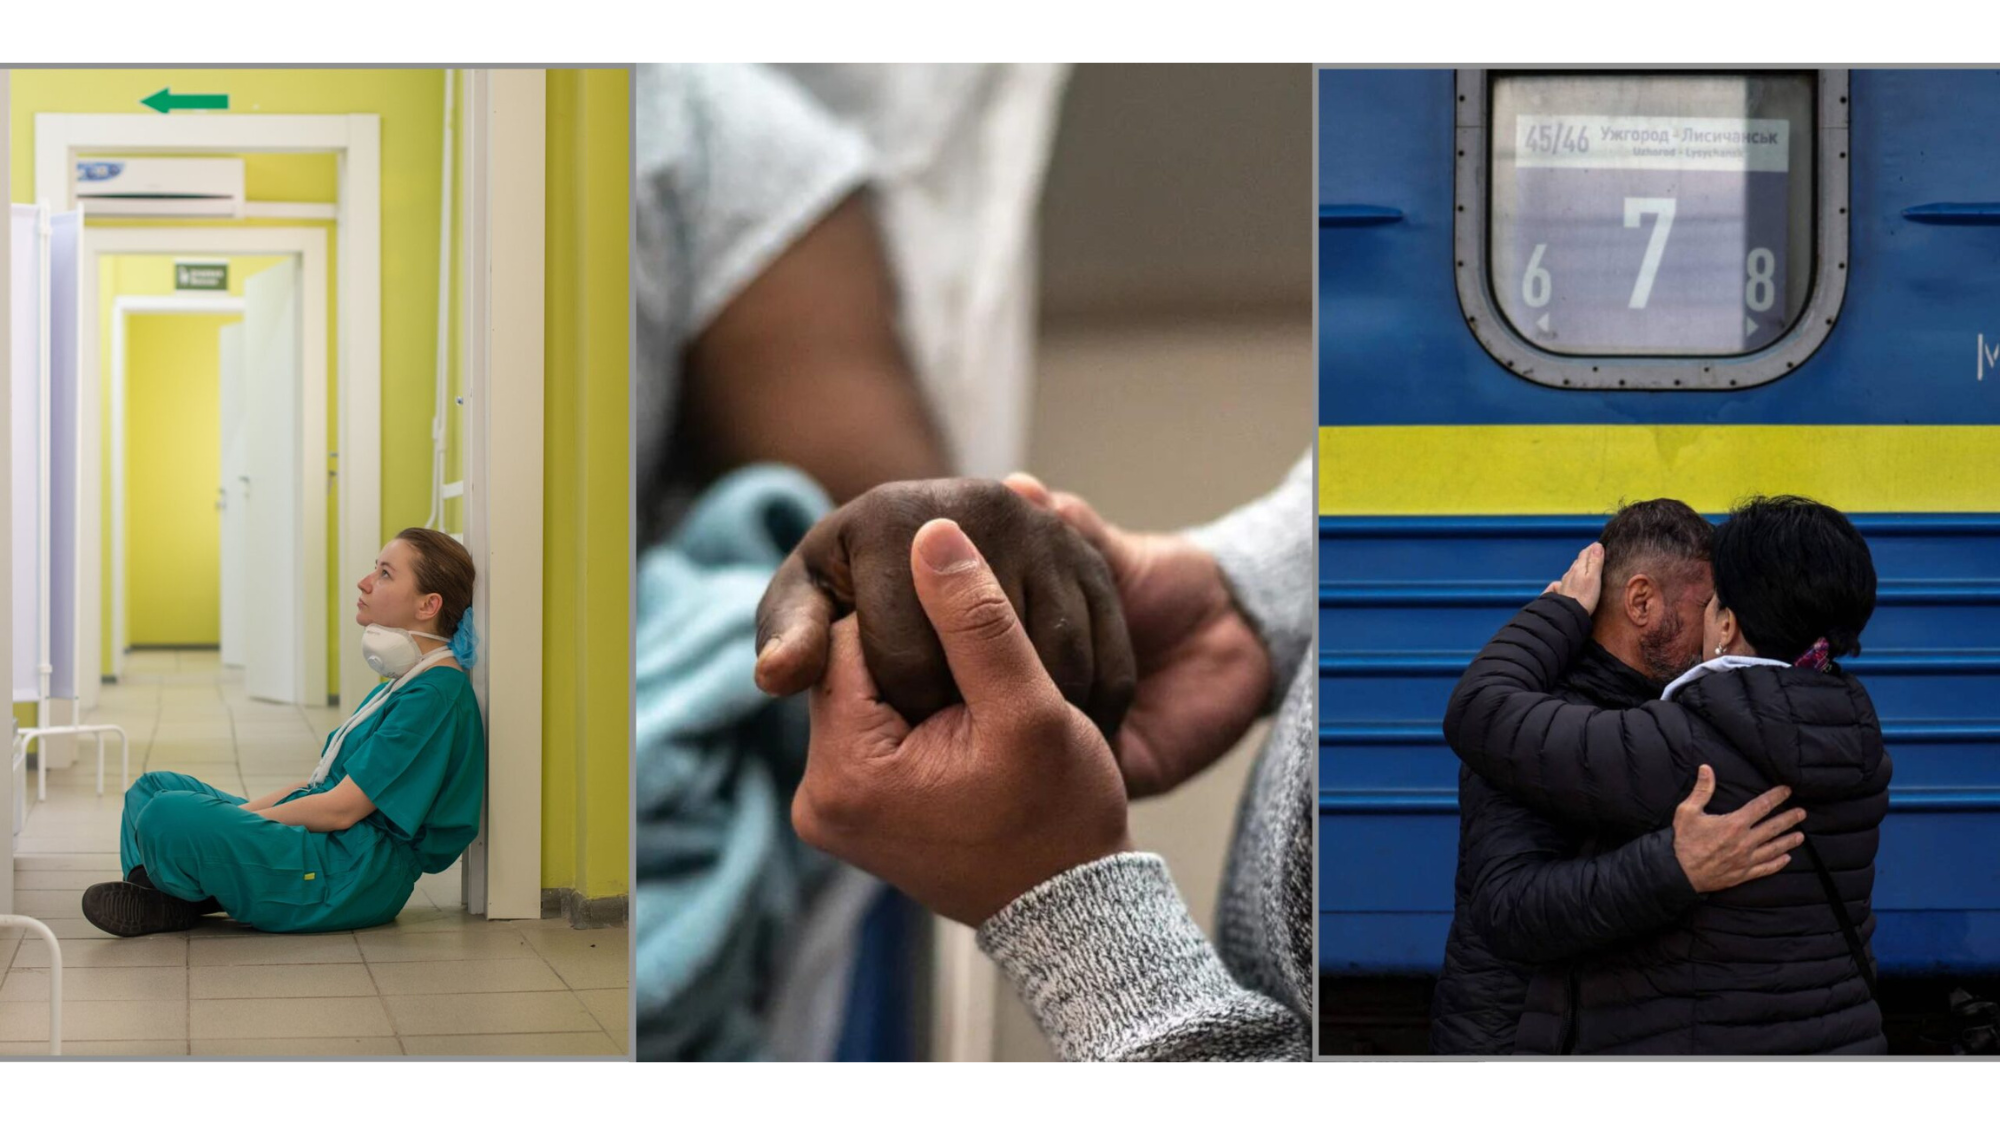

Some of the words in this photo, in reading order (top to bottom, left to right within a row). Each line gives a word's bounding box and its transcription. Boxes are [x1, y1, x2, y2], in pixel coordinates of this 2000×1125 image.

[1524, 122, 1590, 156] 45/46
[1600, 125, 1670, 145] Ужгород
[1681, 127, 1779, 145] Лисичанськ
[1632, 146, 1676, 156] Uzhorod
[1521, 243, 1553, 309] 6
[1622, 196, 1678, 309] 7
[1745, 247, 1776, 313] 8
